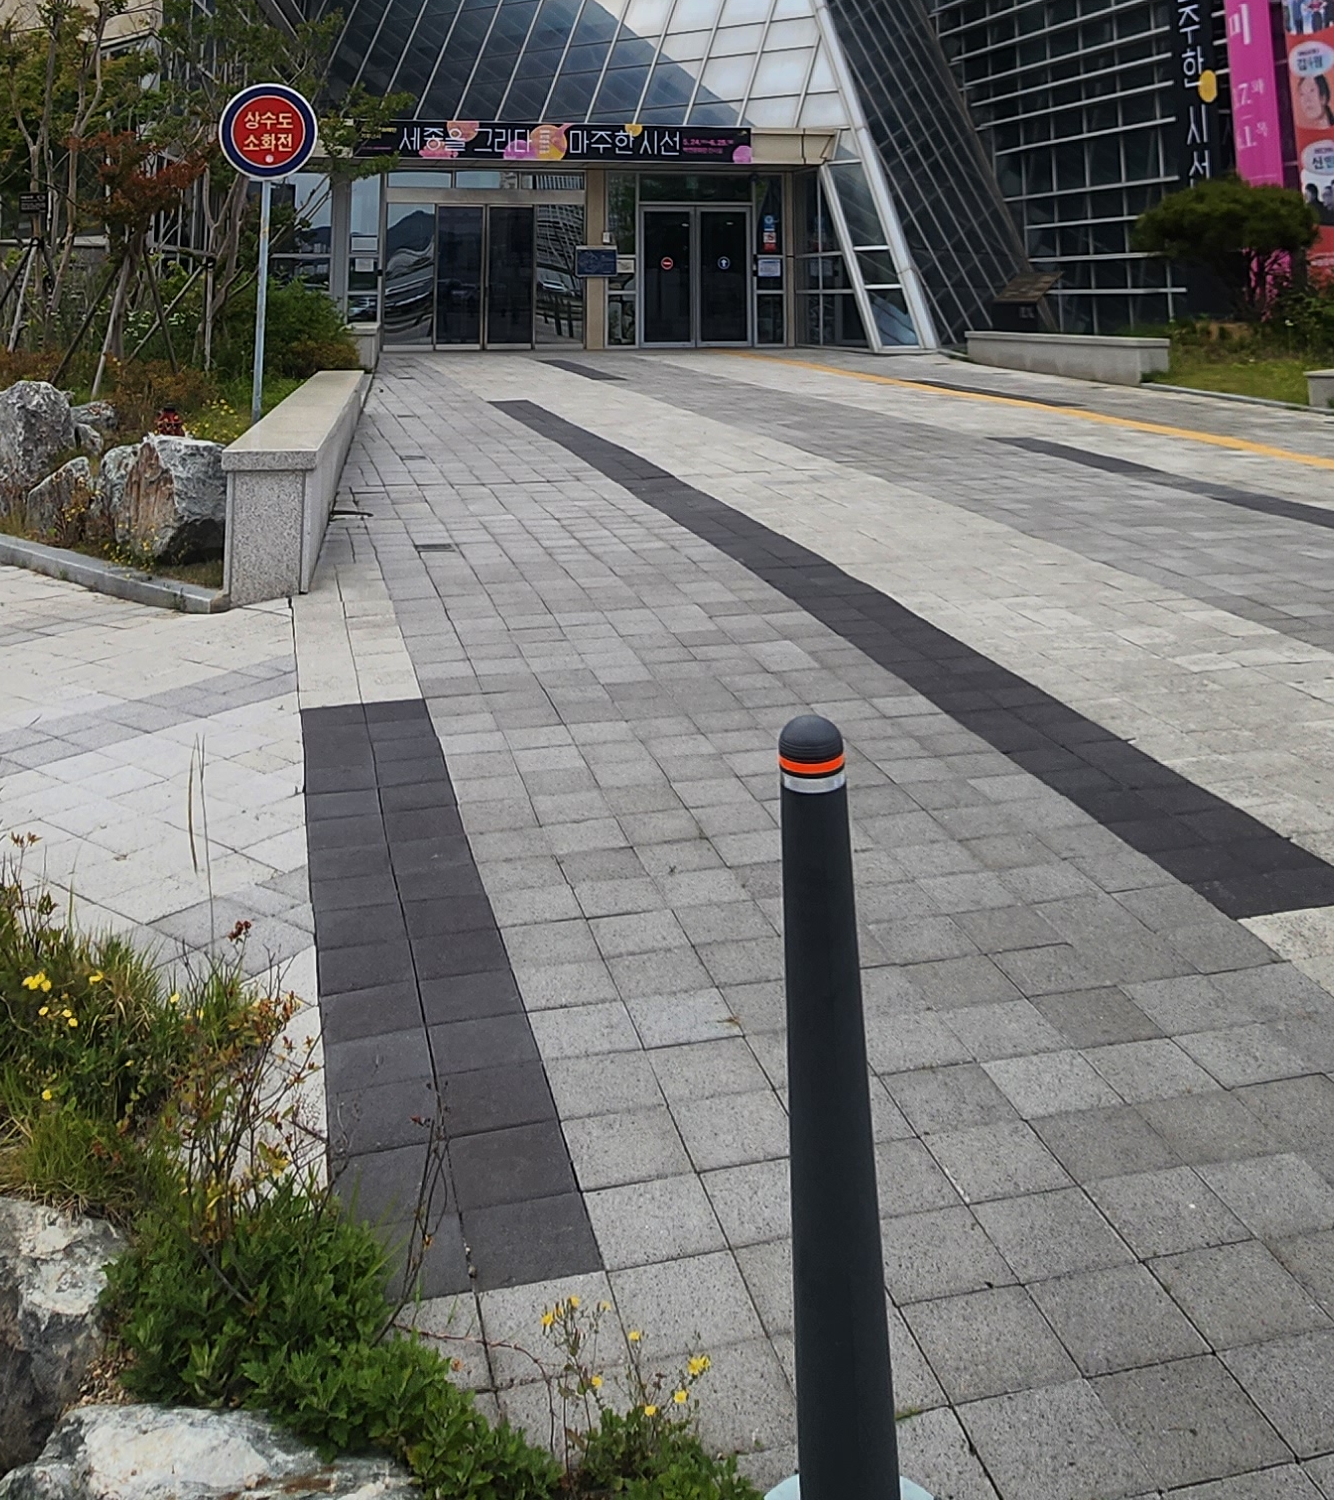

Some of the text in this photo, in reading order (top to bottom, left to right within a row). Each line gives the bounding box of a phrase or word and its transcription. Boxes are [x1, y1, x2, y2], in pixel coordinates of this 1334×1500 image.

[244, 111, 294, 130] 상수도
[242, 133, 293, 152] 소화전
[399, 127, 466, 152] 세종을
[474, 128, 532, 153] 그리다
[569, 130, 634, 155] 마주한
[639, 130, 681, 156] 시선
